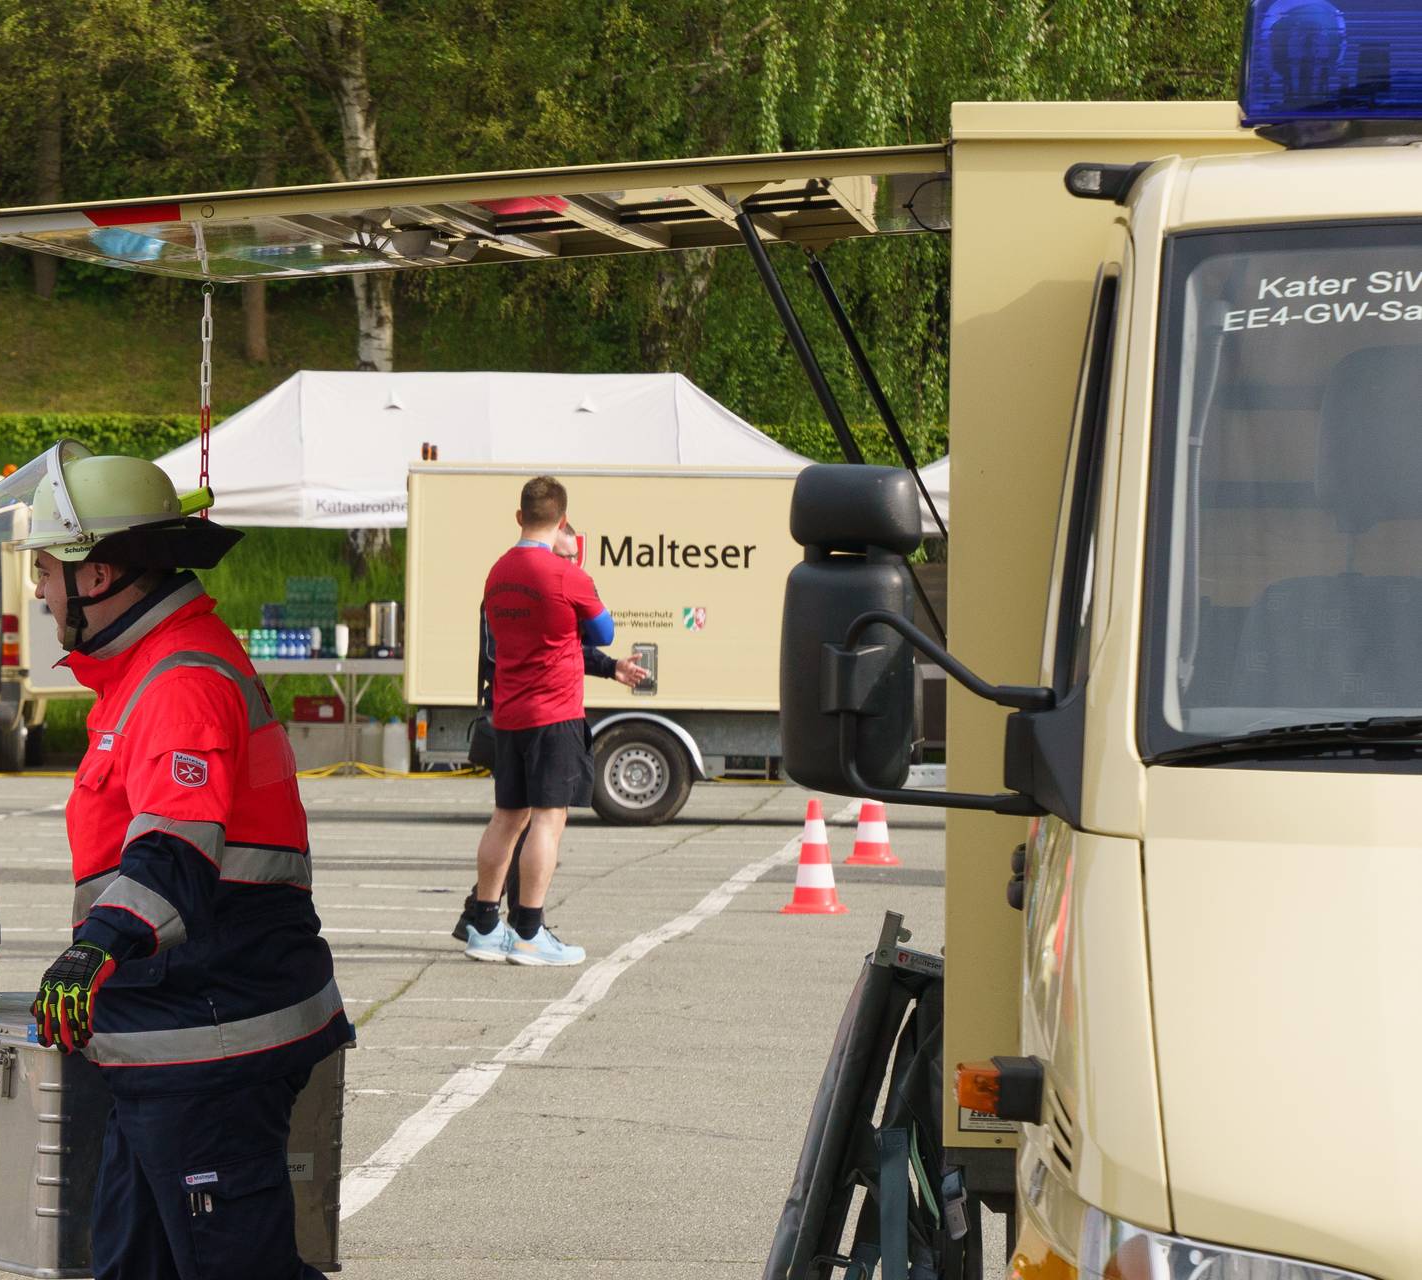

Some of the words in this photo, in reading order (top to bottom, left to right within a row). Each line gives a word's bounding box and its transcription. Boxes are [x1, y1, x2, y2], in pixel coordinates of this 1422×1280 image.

[1258, 275, 1357, 300] Kater
[1223, 300, 1422, 332] EE4-GW-Sa
[600, 534, 756, 569] Malteser
